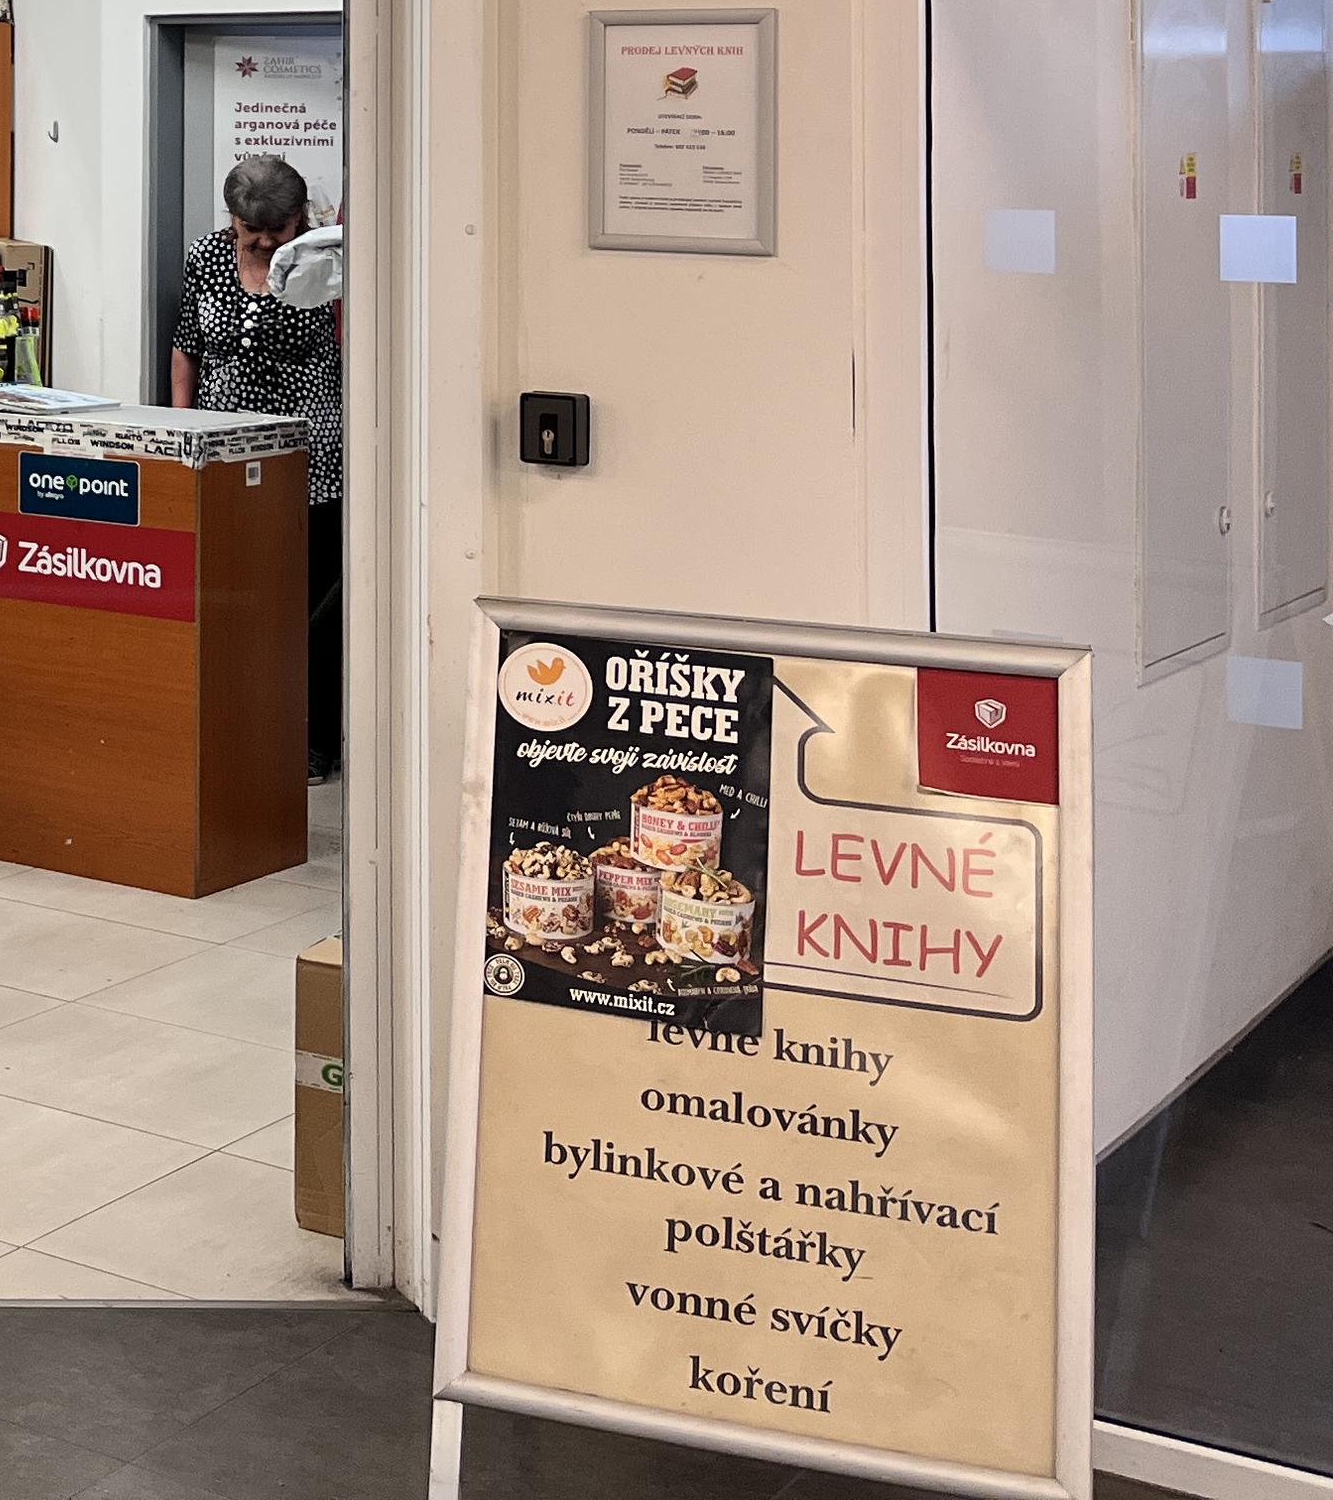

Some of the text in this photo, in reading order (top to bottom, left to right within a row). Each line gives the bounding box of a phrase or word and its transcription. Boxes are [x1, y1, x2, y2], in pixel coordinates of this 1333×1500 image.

[620, 45, 743, 56] PRODEJ LEVNÝCH KNIH
[234, 102, 307, 114] Jedinečná
[234, 119, 337, 132] arganová péče
[234, 137, 241, 145] s
[90, 438, 134, 451] WINDSON
[18, 541, 162, 589] Zásilkovna
[605, 649, 746, 703] OŘÍŠKY
[515, 687, 576, 708] mixit
[607, 696, 739, 744] Z PECE
[516, 739, 739, 775] objevte svoji závislost
[946, 733, 1036, 758] Zásilkovna
[719, 784, 768, 809] MED A CHILLI
[530, 822, 535, 831] A
[641, 813, 675, 830] HONEY
[676, 821, 685, 831] &
[599, 871, 653, 886] PEPPER MIX
[794, 830, 996, 899] LEVNÉ
[511, 878, 572, 897] SESAME MIX
[797, 909, 1004, 979] KNIHY
[569, 986, 675, 1016] www.mixit.cz
[773, 1028, 893, 1087] knihy
[640, 1087, 900, 1157] omalovánky
[542, 1131, 1001, 1235] bylinkové a nahřívací
[664, 1215, 868, 1281] polštářky
[625, 1279, 904, 1361] vonné svíčky
[689, 1355, 834, 1414] koření
